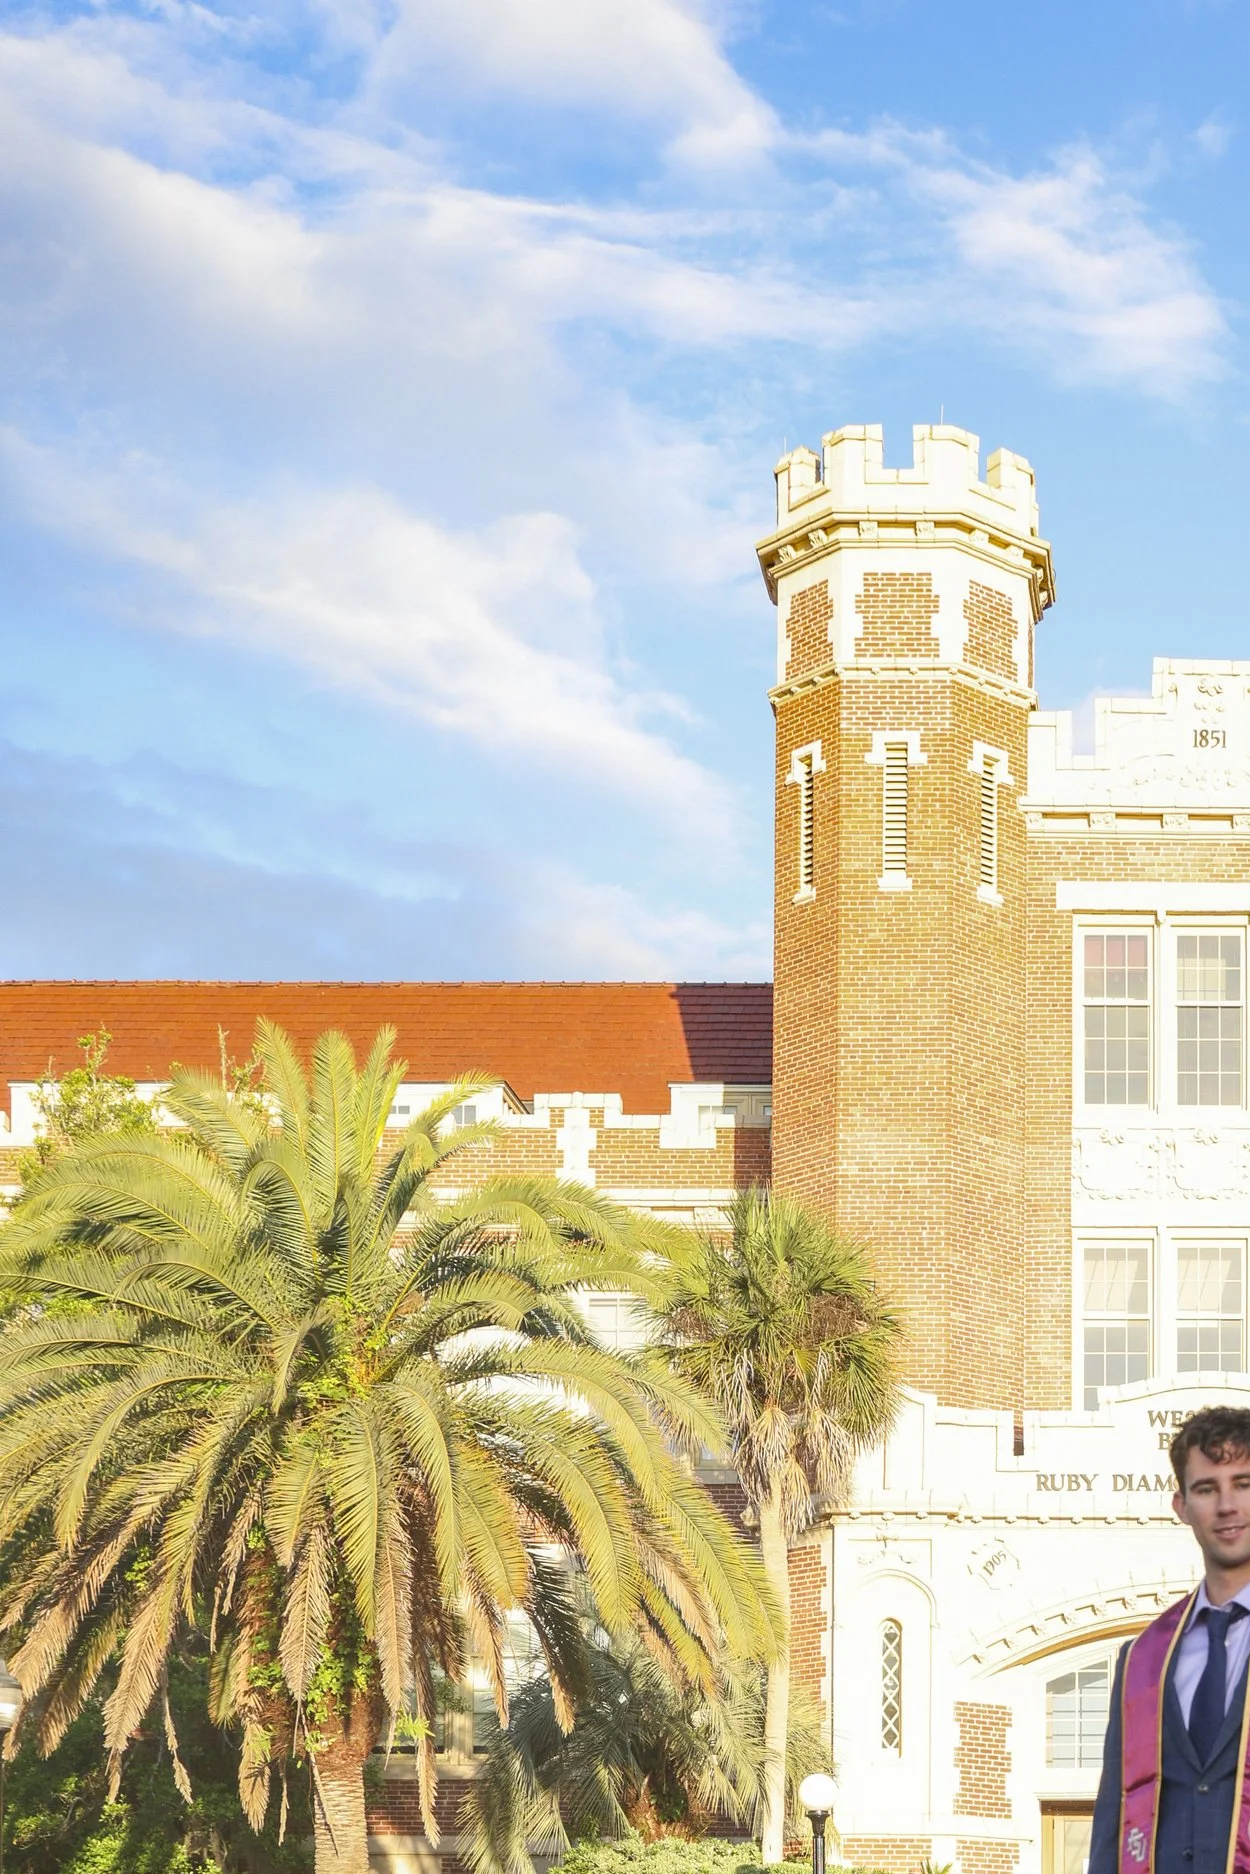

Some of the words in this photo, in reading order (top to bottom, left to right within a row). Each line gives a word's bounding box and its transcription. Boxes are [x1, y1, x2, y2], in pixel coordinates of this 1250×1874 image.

[1192, 729, 1227, 749] 1851
[1035, 1473, 1099, 1492] RUBY
[1111, 1473, 1180, 1492] DIAM
[983, 1550, 1007, 1576] 1905
